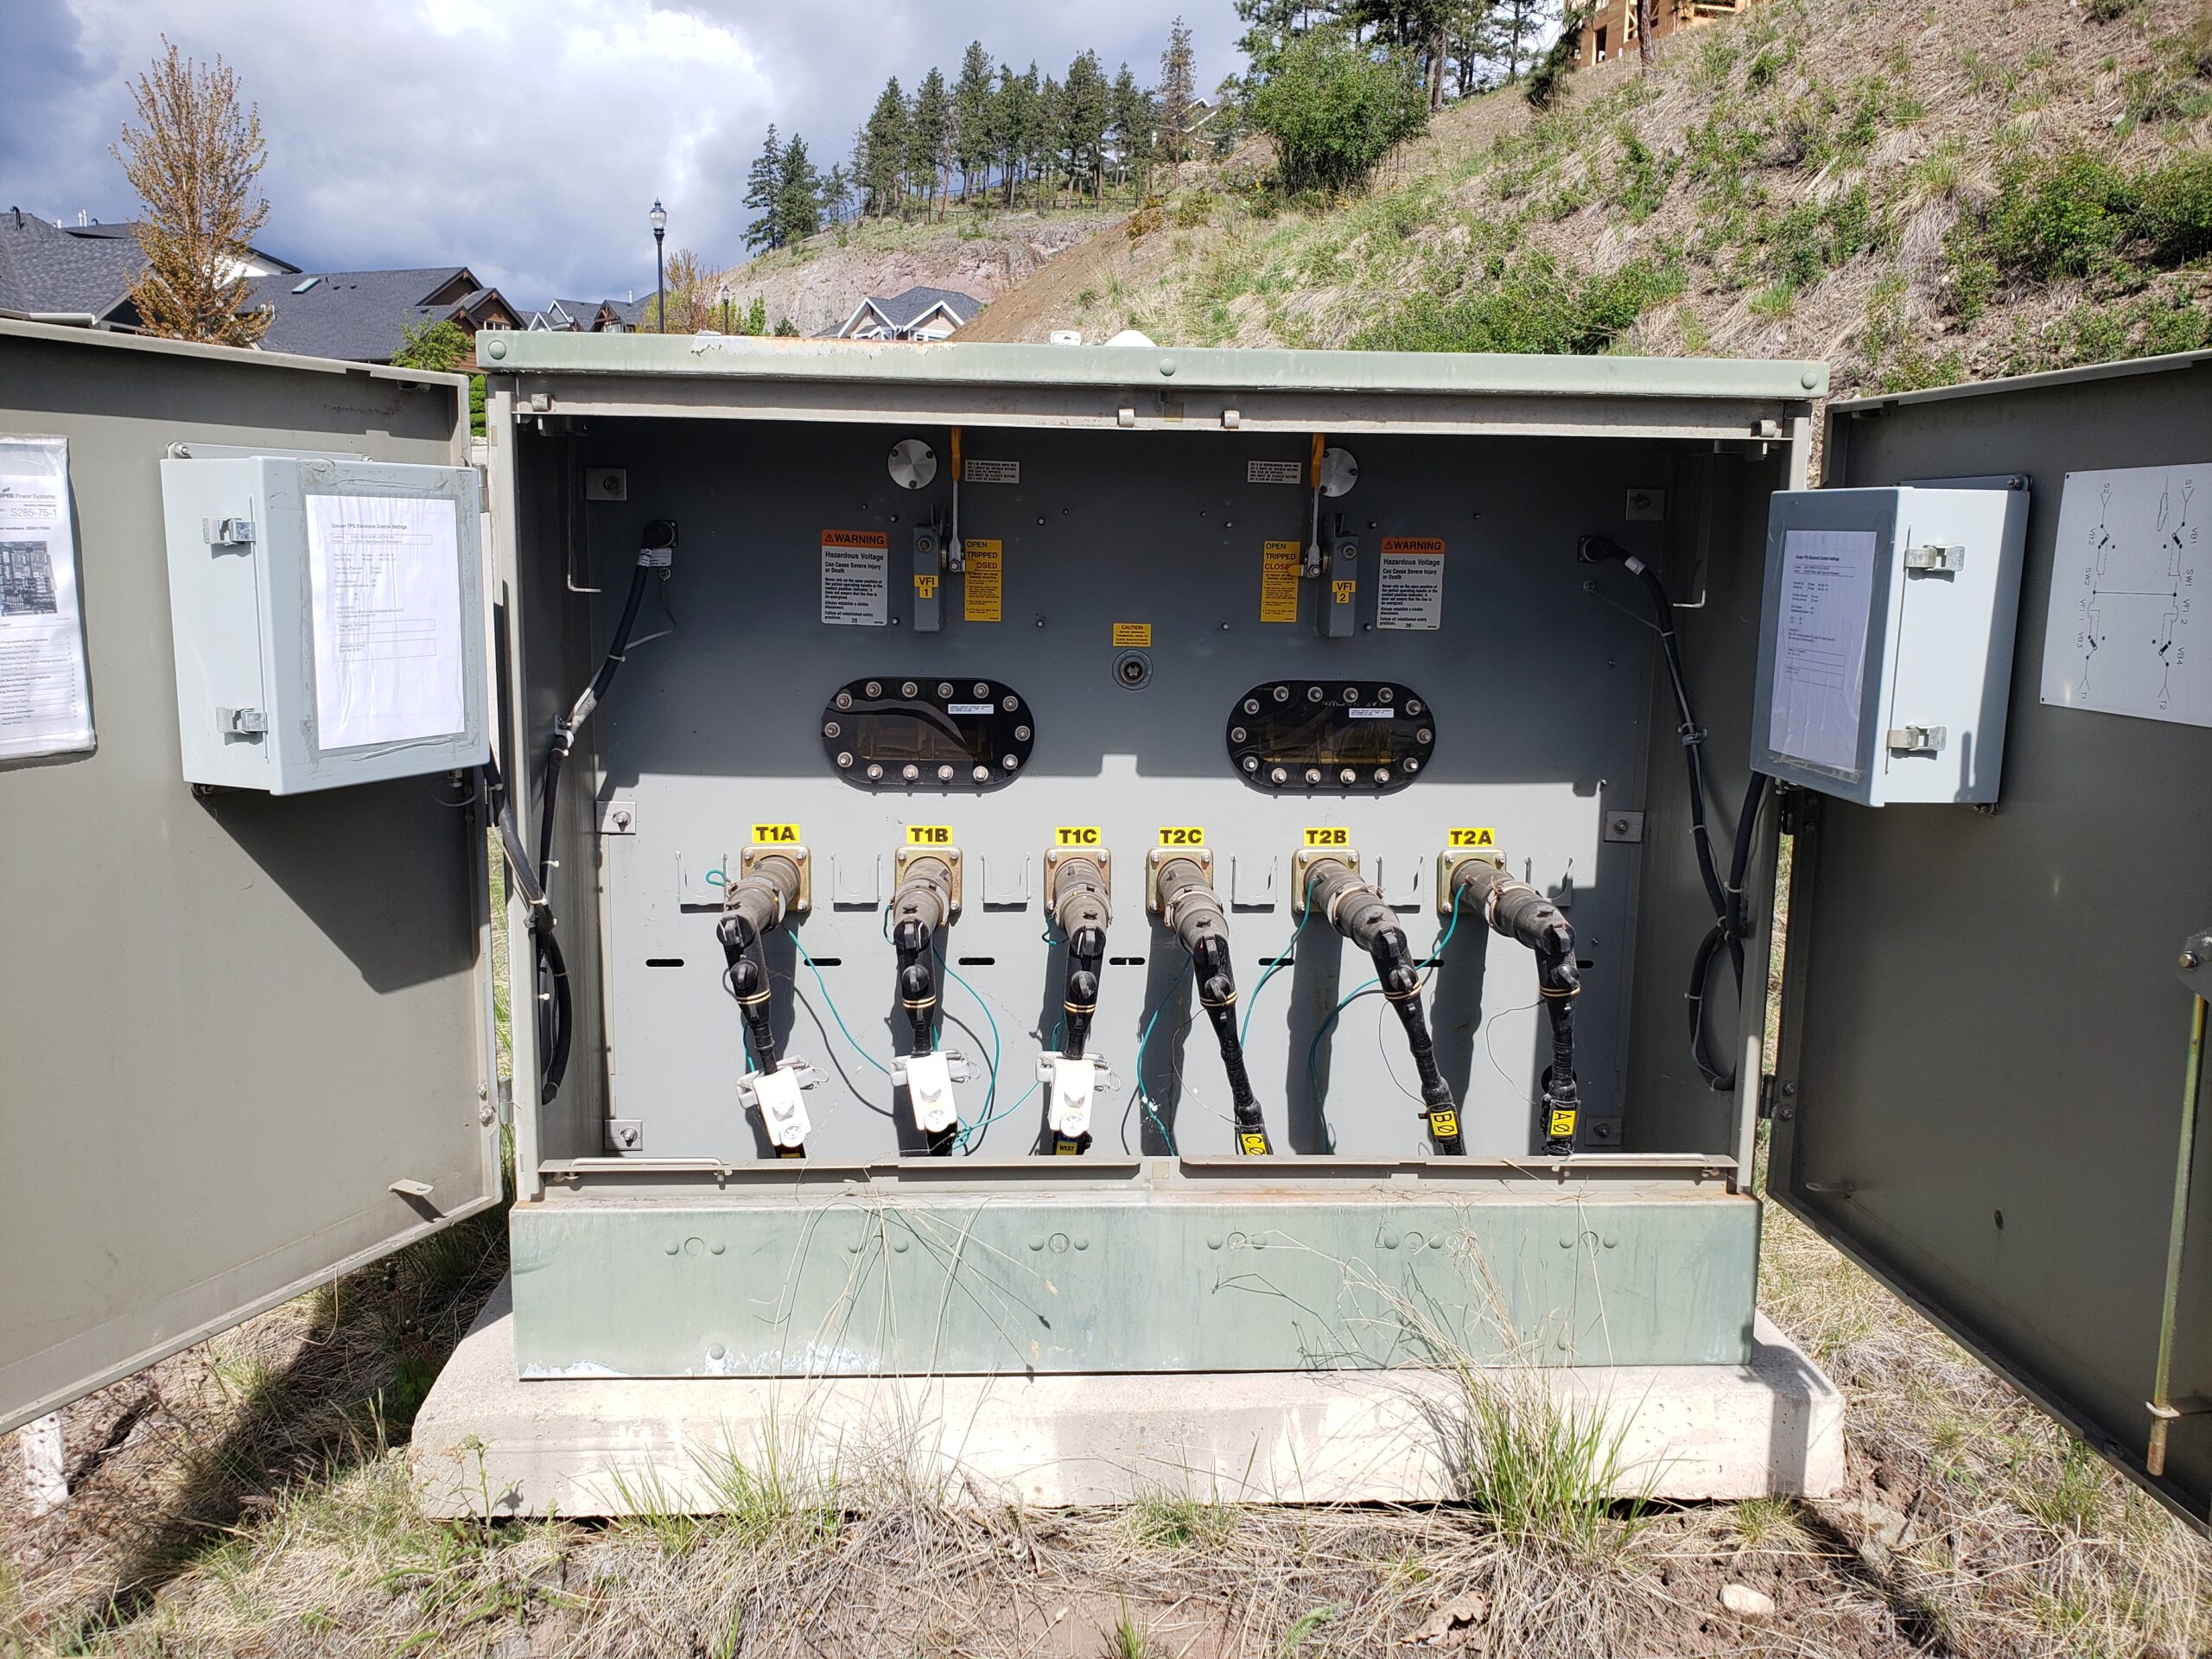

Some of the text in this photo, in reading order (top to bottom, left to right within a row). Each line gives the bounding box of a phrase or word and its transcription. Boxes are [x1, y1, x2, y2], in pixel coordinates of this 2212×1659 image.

[2104, 483, 2110, 494] S2
[2185, 479, 2192, 489] S1
[11, 508, 57, 517] S285-75-1
[835, 534, 884, 544] WARNING
[2190, 527, 2199, 544] VB1
[1394, 541, 1441, 550] WARNING
[860, 553, 884, 562] Voltage
[1418, 559, 1440, 567] Voltage
[919, 577, 934, 585] VFI
[2185, 569, 2193, 587] SW1
[1337, 582, 1352, 590] VFI
[1340, 593, 1346, 601] 2
[2182, 599, 2190, 613] VFI
[2176, 647, 2185, 665] VB4
[2160, 700, 2166, 711] T2
[756, 826, 796, 841] T1A
[911, 828, 948, 842] T1B
[1059, 829, 1097, 843] T1C
[1160, 829, 1202, 844] T2C
[1306, 830, 1347, 844] T2B
[1450, 831, 1492, 845] T2A
